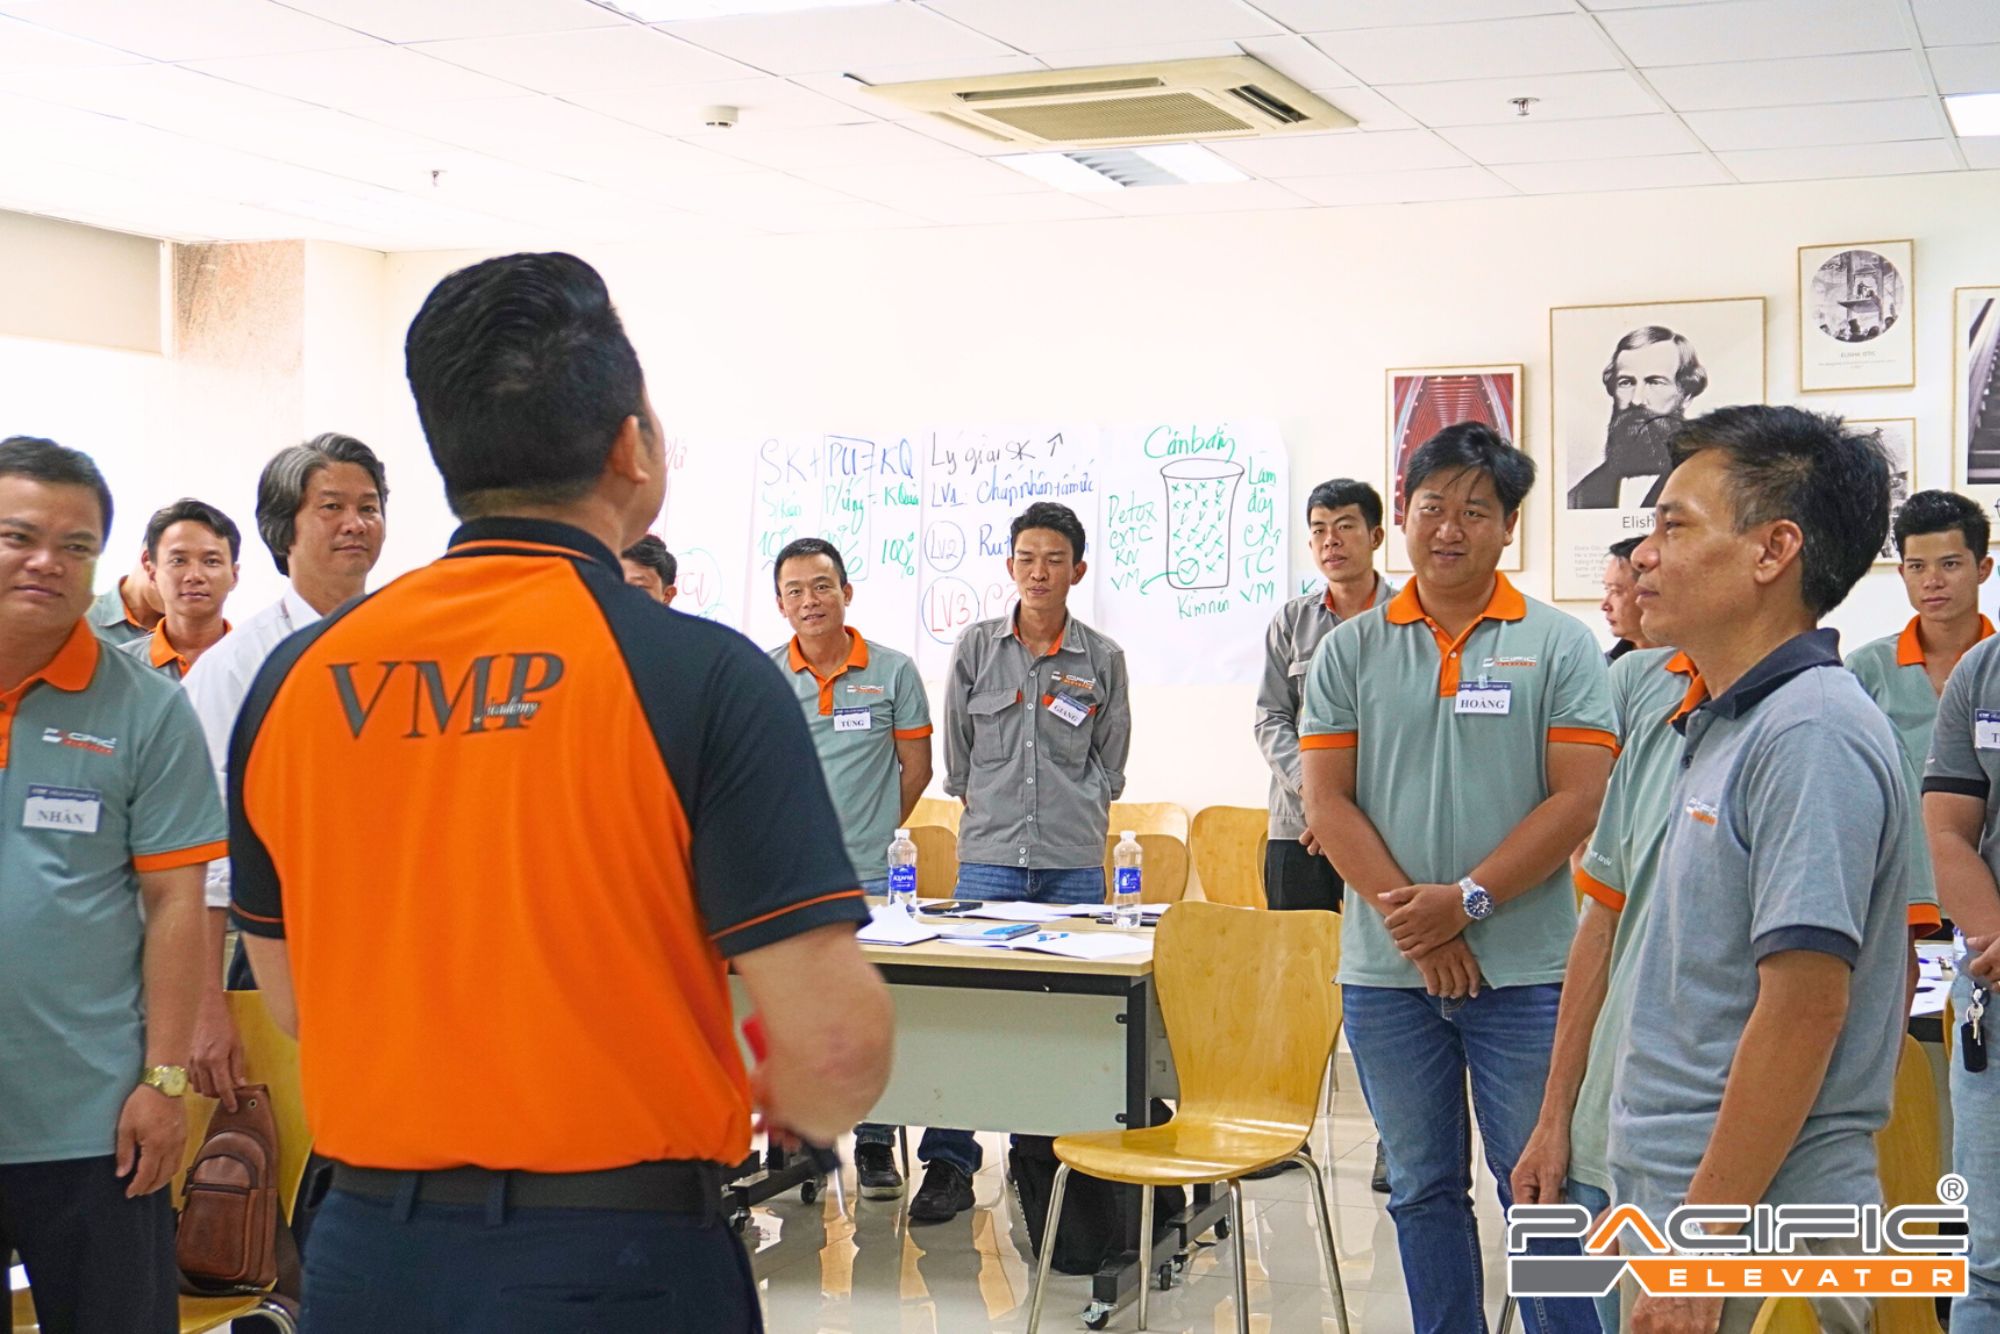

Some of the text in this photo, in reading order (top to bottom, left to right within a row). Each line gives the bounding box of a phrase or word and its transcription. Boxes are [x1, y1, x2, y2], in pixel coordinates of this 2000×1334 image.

[1622, 515, 1655, 529] Elish
[930, 585, 971, 632] LV3
[326, 652, 565, 740] VMP
